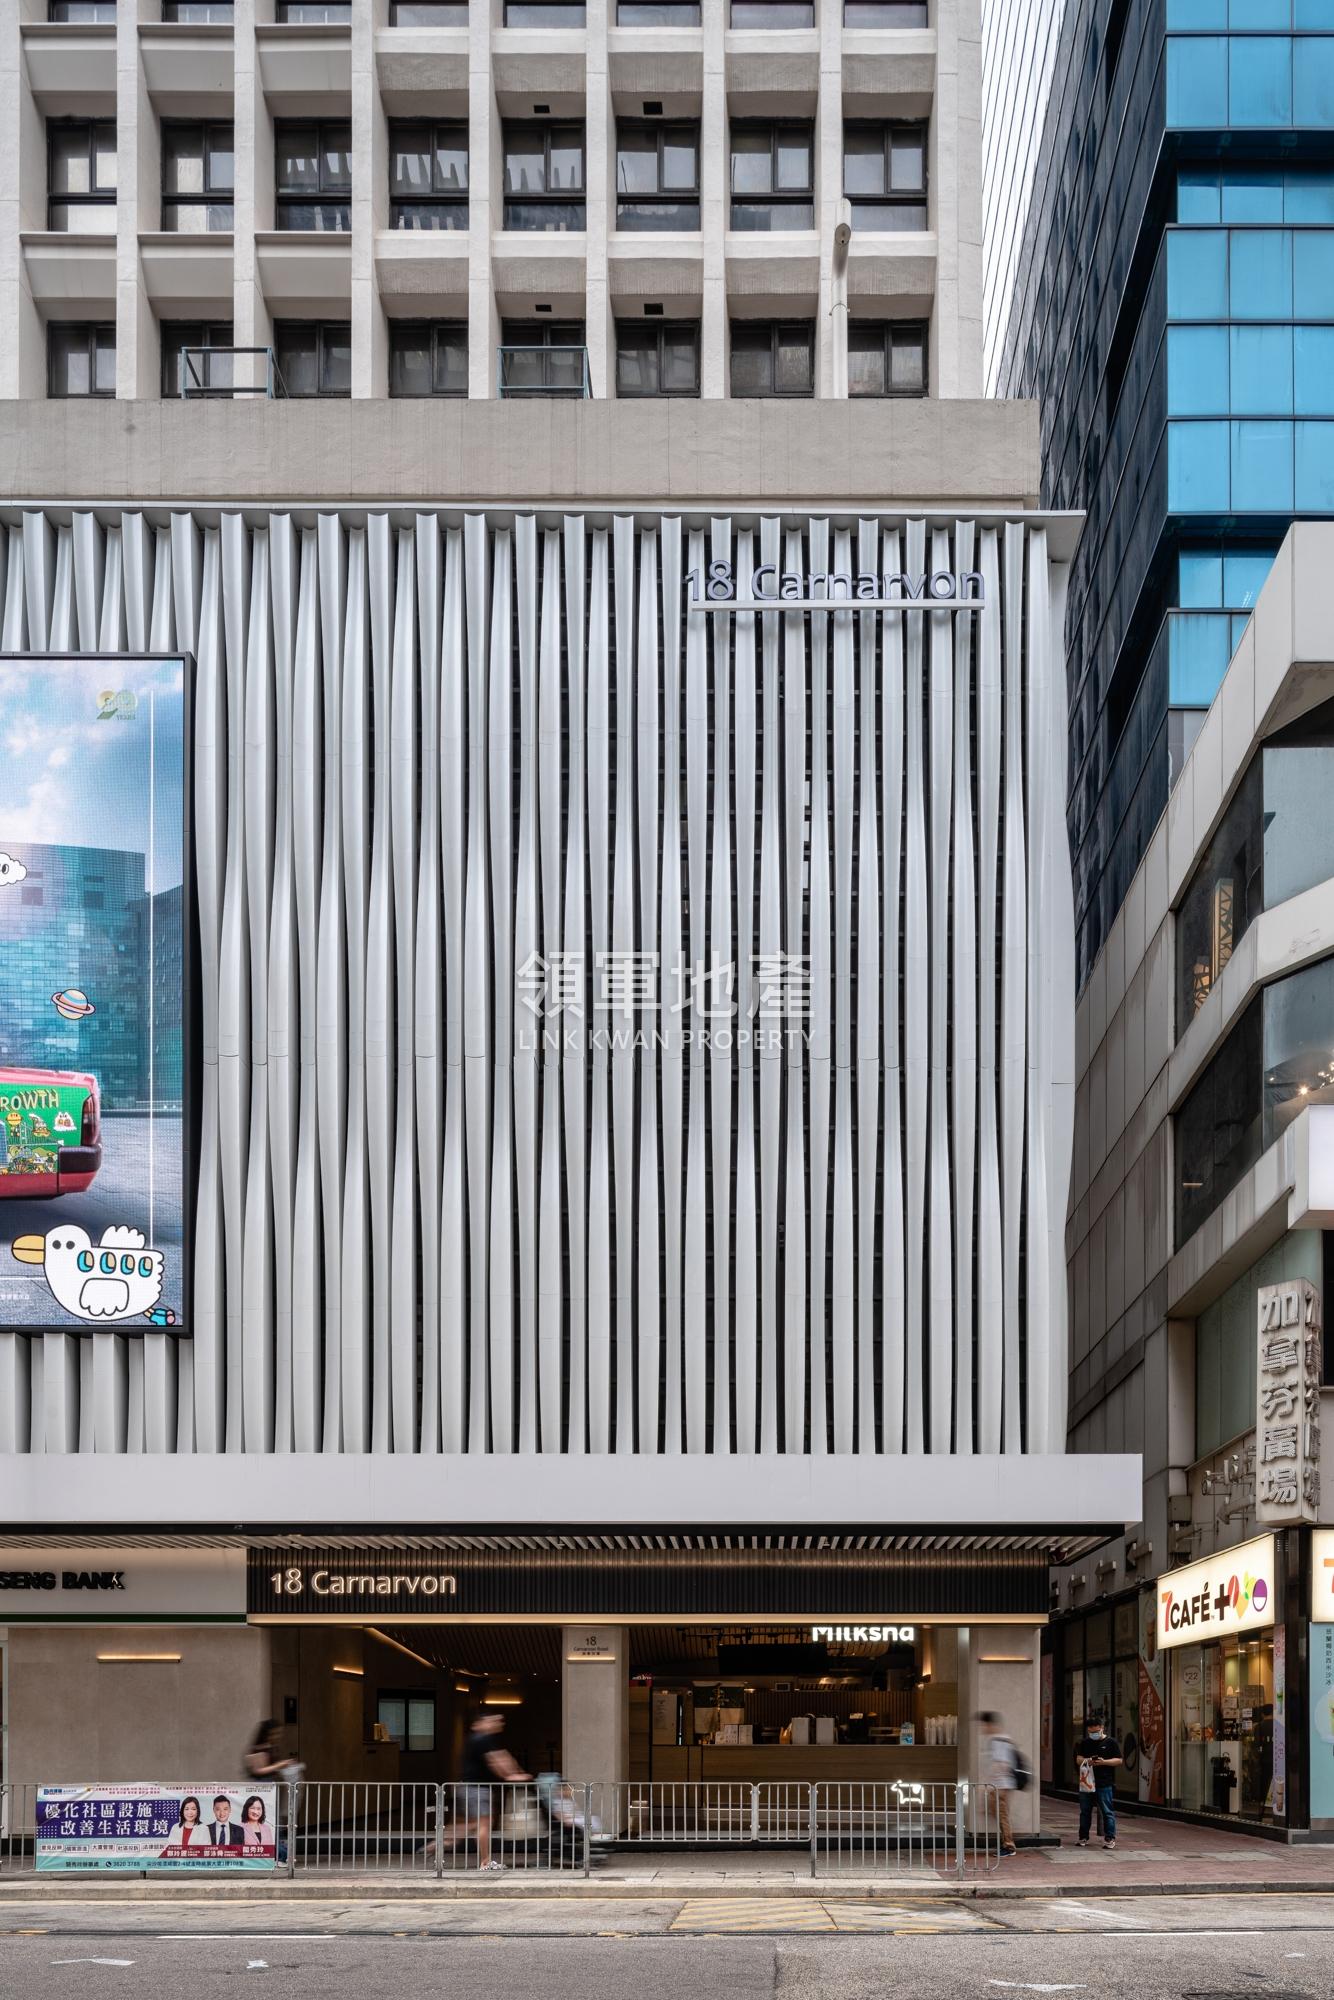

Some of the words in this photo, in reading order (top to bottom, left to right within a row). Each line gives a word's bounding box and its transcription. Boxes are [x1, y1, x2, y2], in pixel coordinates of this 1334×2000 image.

[684, 559, 735, 600] 18
[751, 564, 985, 600] Carnarvon
[0, 1571, 57, 1590] SENG
[62, 1571, 126, 1590] BANK
[271, 1567, 303, 1594] 18
[311, 1571, 456, 1594] Carnarvon
[585, 1636, 597, 1646] 18
[45, 1802, 153, 1819] 優化社區設施
[60, 1819, 169, 1836] 改善生活環境
